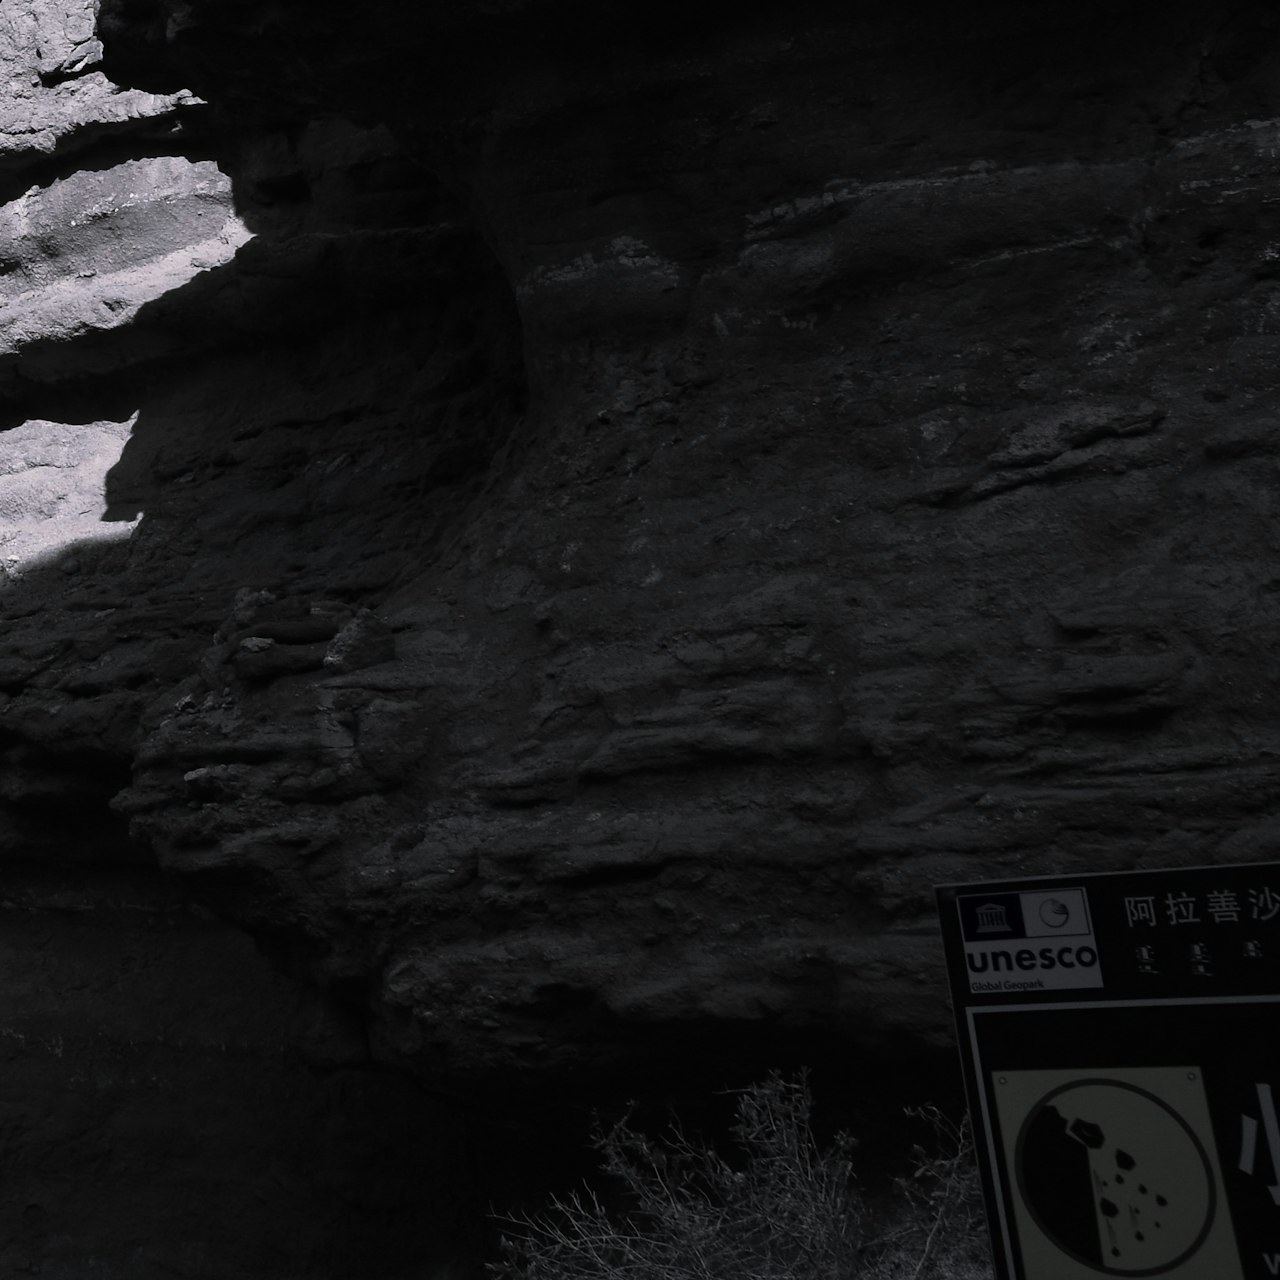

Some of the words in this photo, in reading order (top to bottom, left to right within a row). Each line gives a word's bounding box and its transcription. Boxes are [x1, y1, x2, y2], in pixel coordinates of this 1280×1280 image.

[1124, 886, 1280, 928] 阿拉善沙
[967, 946, 1097, 973] unesco
[971, 981, 1002, 993] Global
[1004, 979, 1045, 993] Geopark
